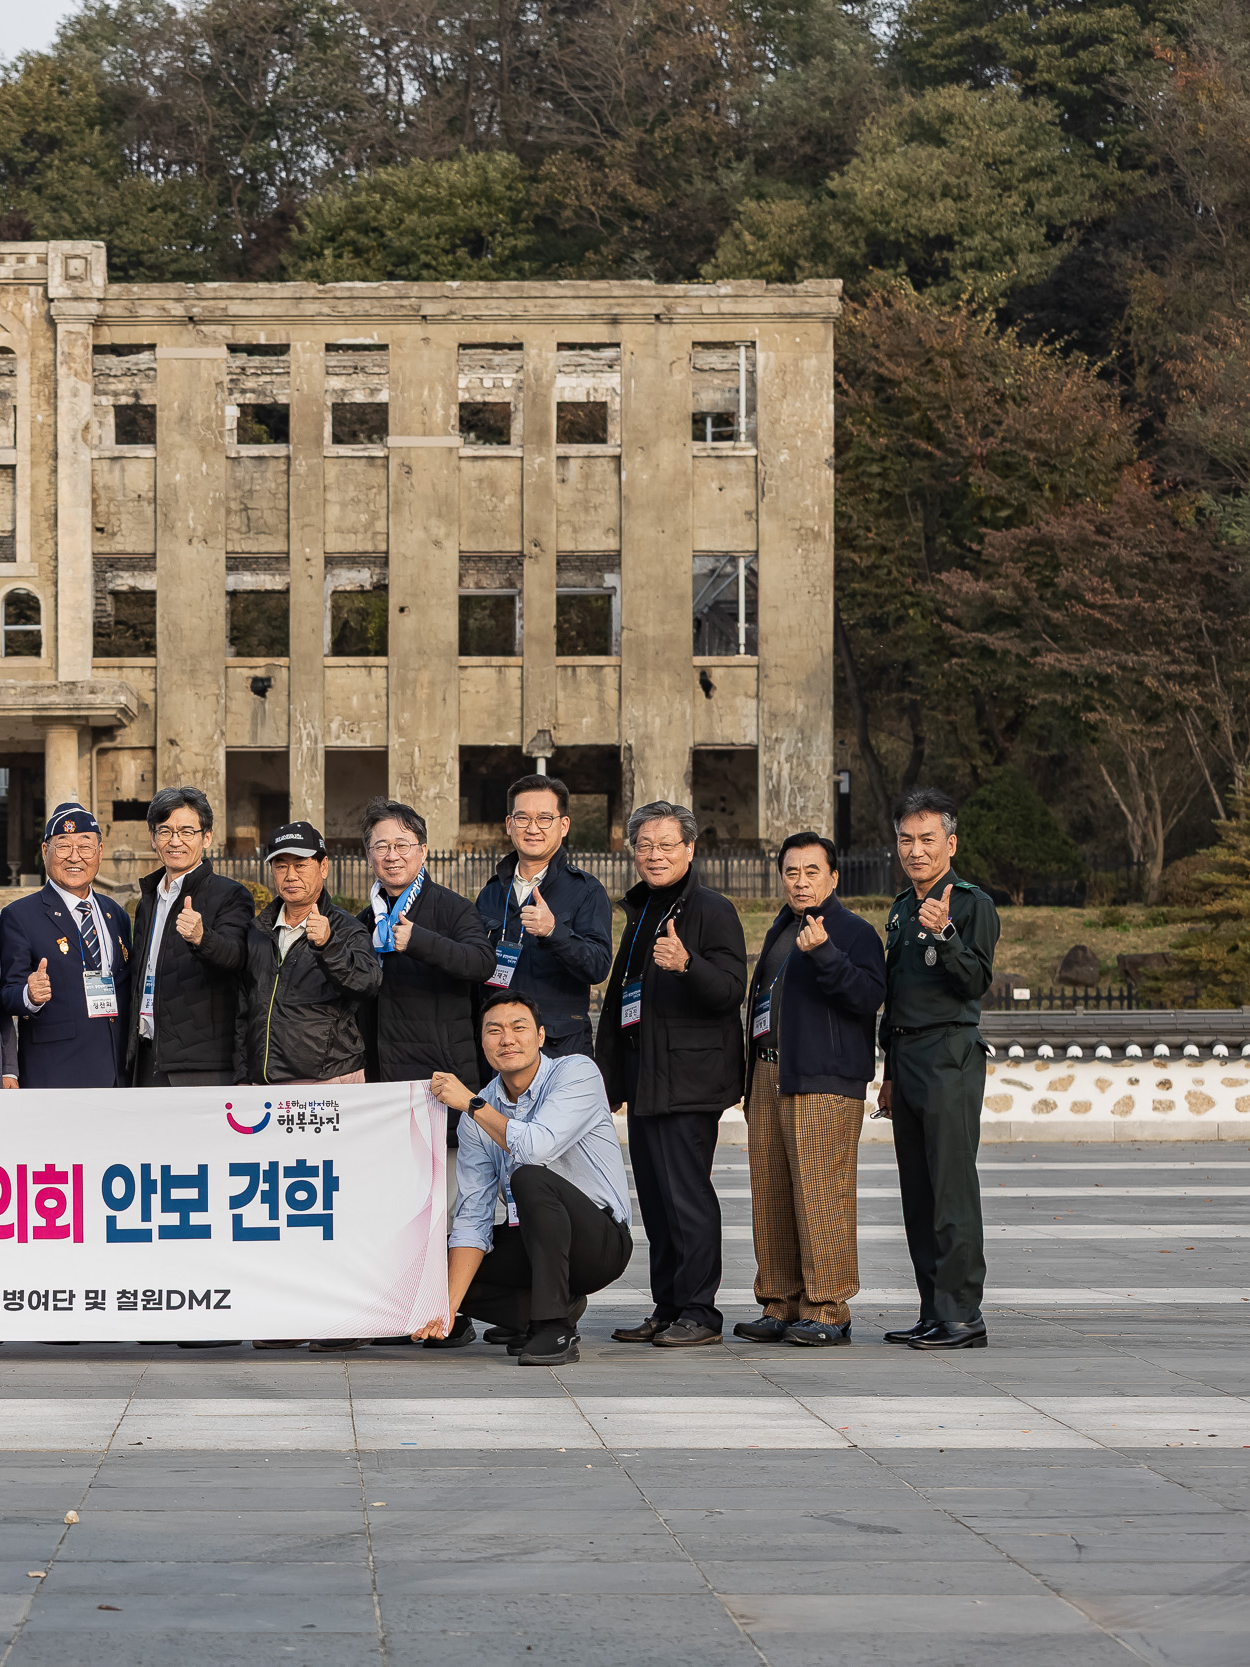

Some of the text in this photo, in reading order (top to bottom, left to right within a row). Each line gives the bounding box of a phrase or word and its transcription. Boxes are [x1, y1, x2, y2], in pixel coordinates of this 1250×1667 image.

[277, 1100, 339, 1113] 소통하며 발전하는
[277, 1112, 340, 1134] 행복광진
[101, 1162, 212, 1244] 안보
[228, 1158, 340, 1242] 견학
[84, 1289, 107, 1311] 및
[116, 1289, 232, 1311] 철원DMZ
